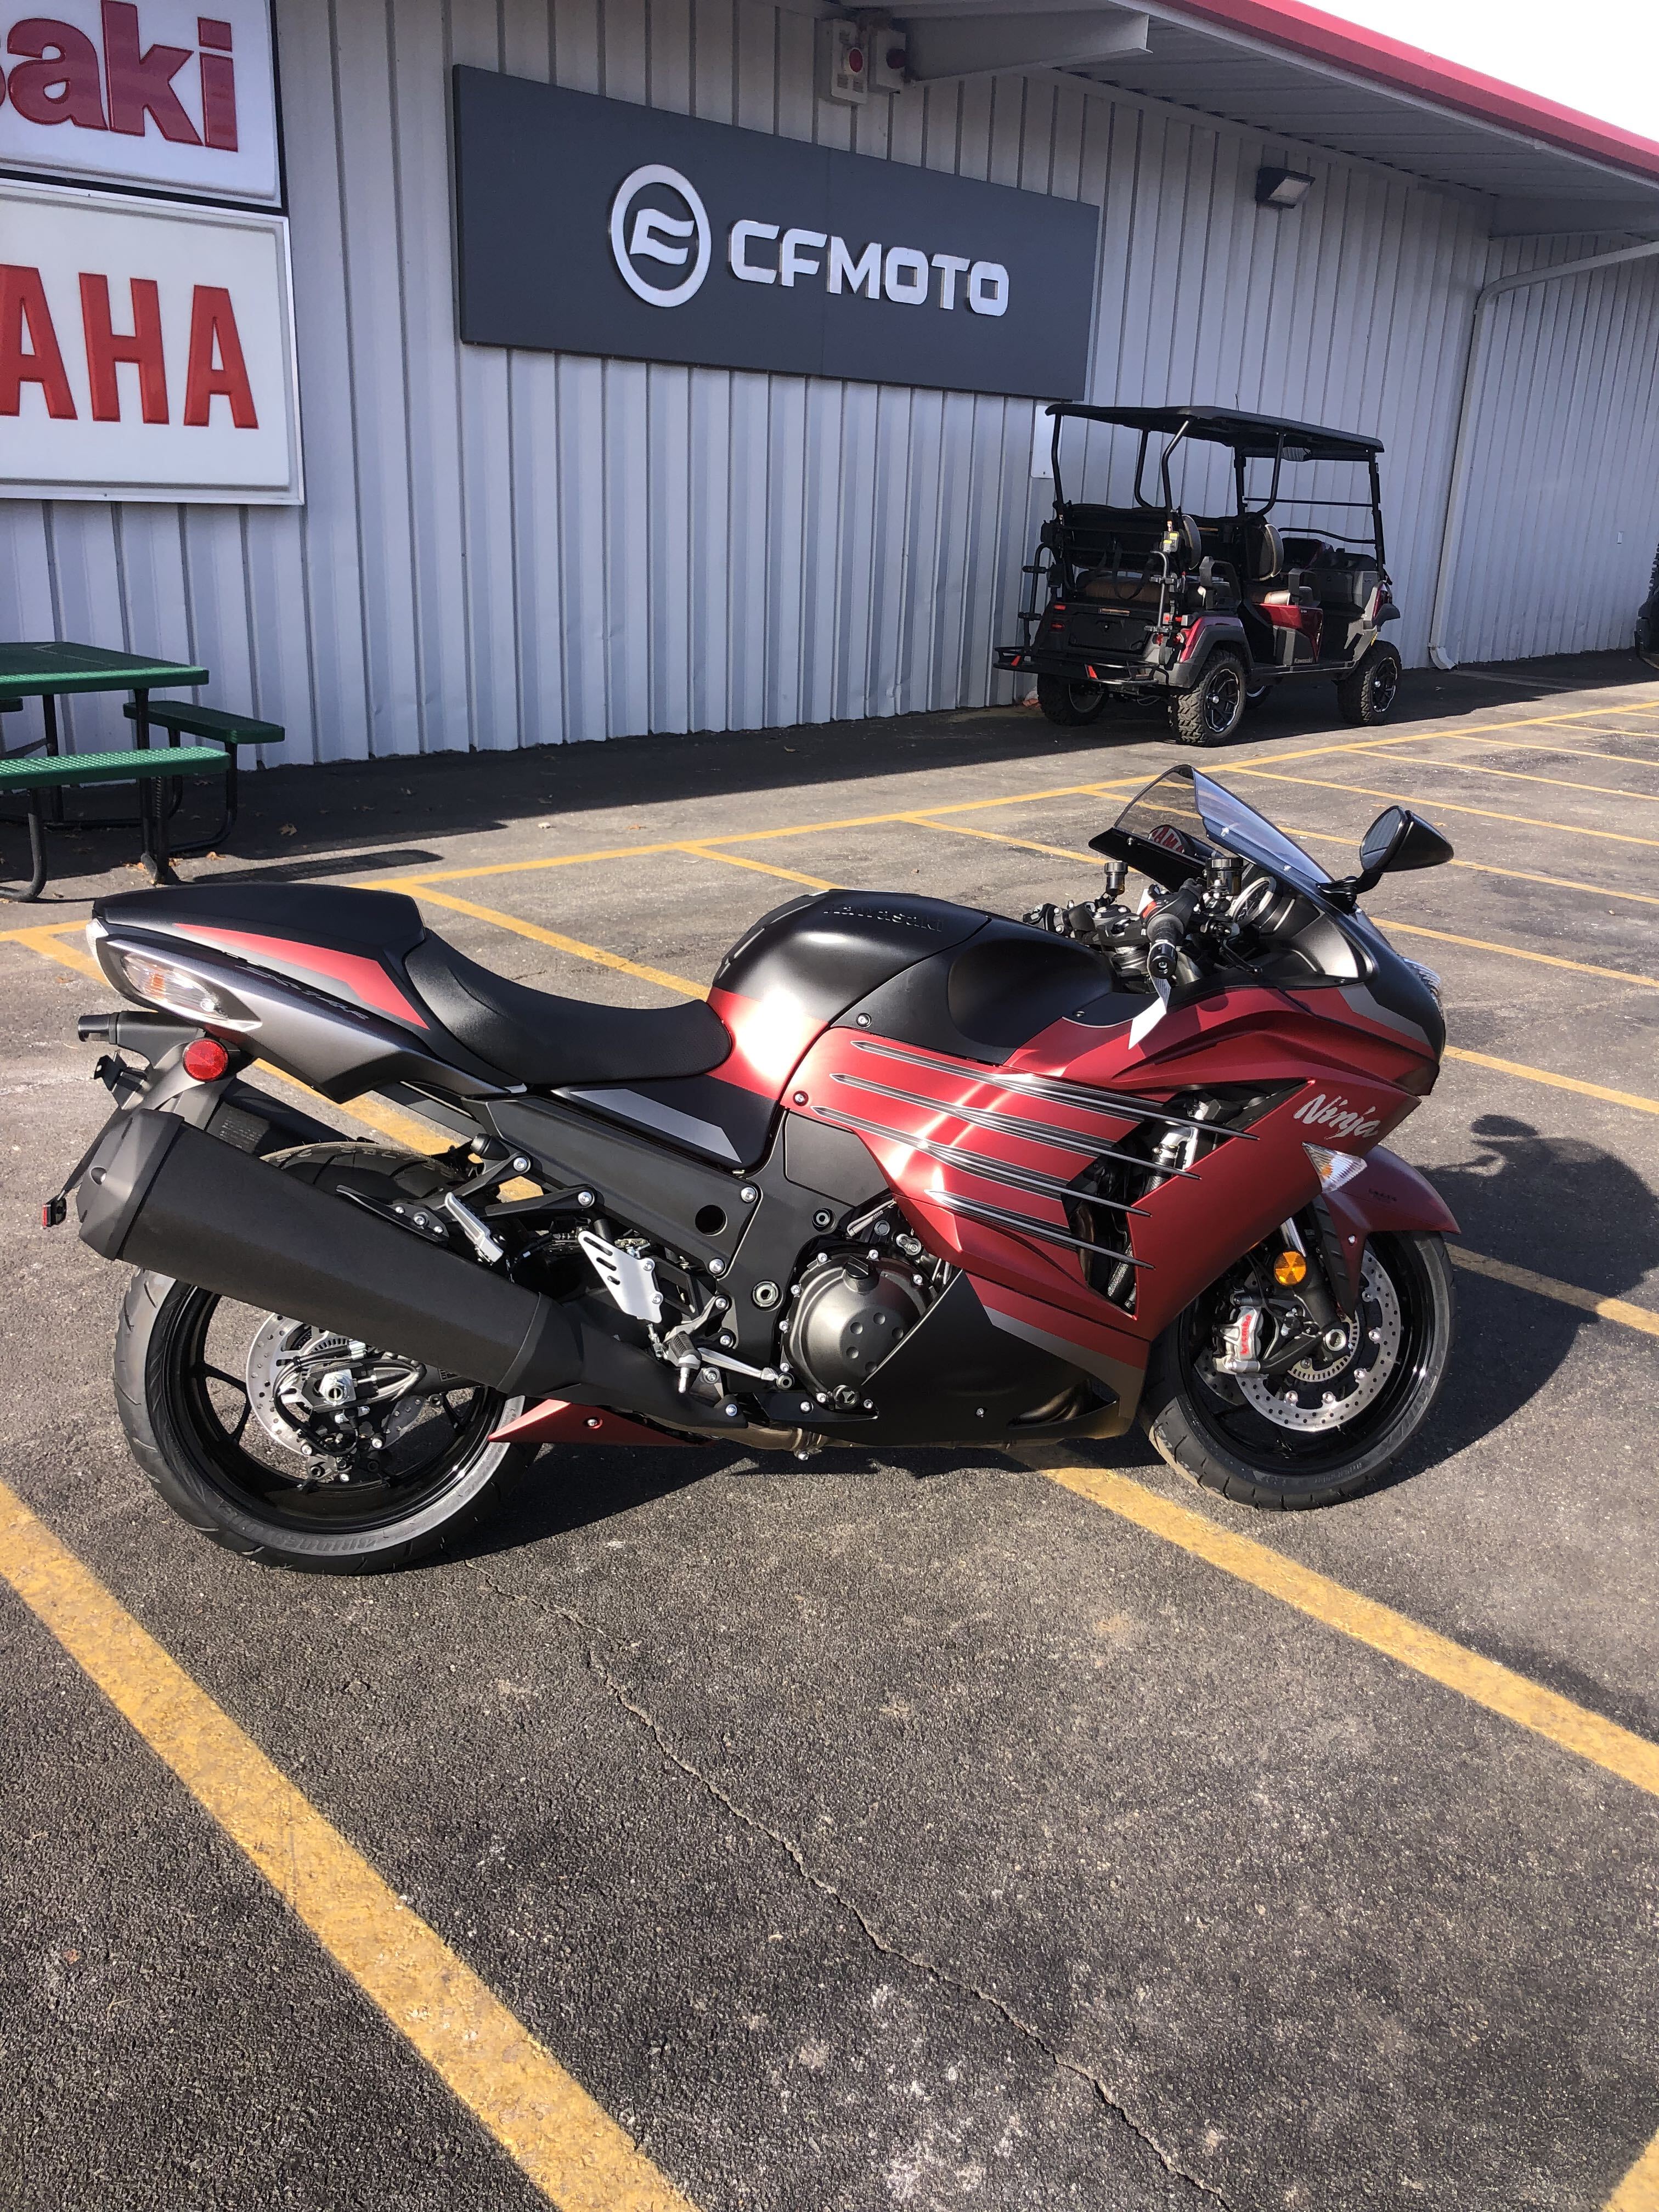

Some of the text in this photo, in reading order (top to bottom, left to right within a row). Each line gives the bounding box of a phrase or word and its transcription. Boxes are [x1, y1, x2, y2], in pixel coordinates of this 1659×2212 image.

[0, 0, 238, 152] aki
[729, 219, 1009, 317] CFMOTO
[1293, 1093, 1381, 1140] Ninja
[1240, 1314, 1252, 1355] brembo
